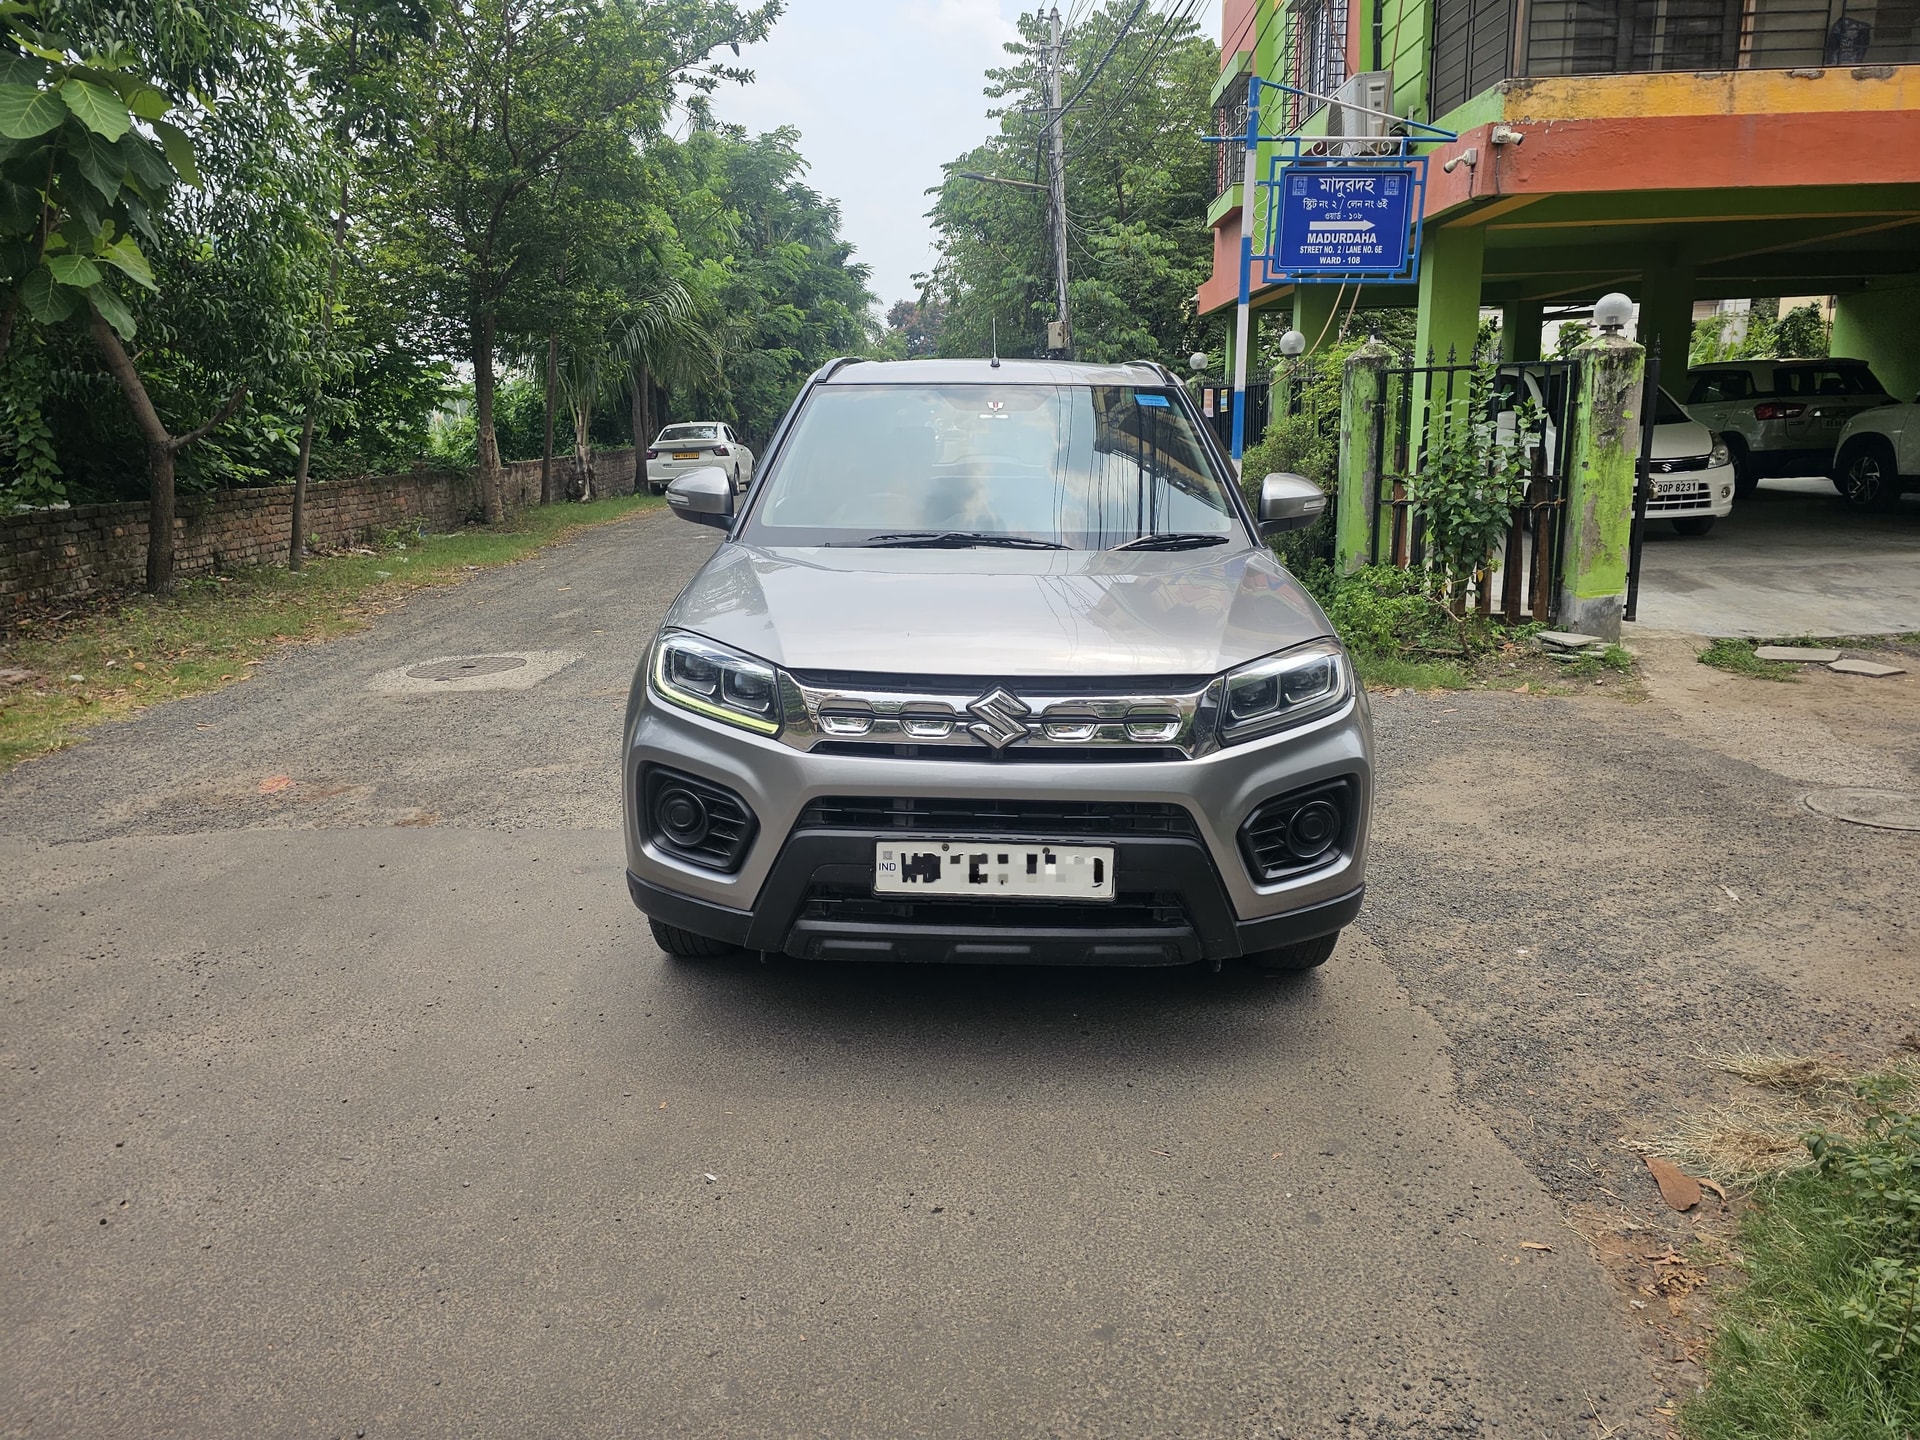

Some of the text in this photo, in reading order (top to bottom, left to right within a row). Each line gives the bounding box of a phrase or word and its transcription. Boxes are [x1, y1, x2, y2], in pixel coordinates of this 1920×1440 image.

[1319, 176, 1376, 198] মাদুরদহ
[1319, 200, 1329, 209] নং
[1331, 201, 1337, 209] ২
[1347, 200, 1363, 209] লেন
[1364, 200, 1375, 209] নং
[1348, 212, 1363, 220] ১০৮
[1307, 232, 1377, 244] MADURDAHA
[1299, 245, 1323, 254] STREET
[1323, 245, 1335, 254] NO.
[1345, 245, 1362, 254] LANE
[1362, 245, 1374, 254] NO.
[1374, 245, 1383, 254] 6E
[1319, 256, 1341, 264] WARD
[1347, 256, 1361, 264] 108
[1675, 482, 1696, 492] 8231
[878, 862, 897, 872] IND
